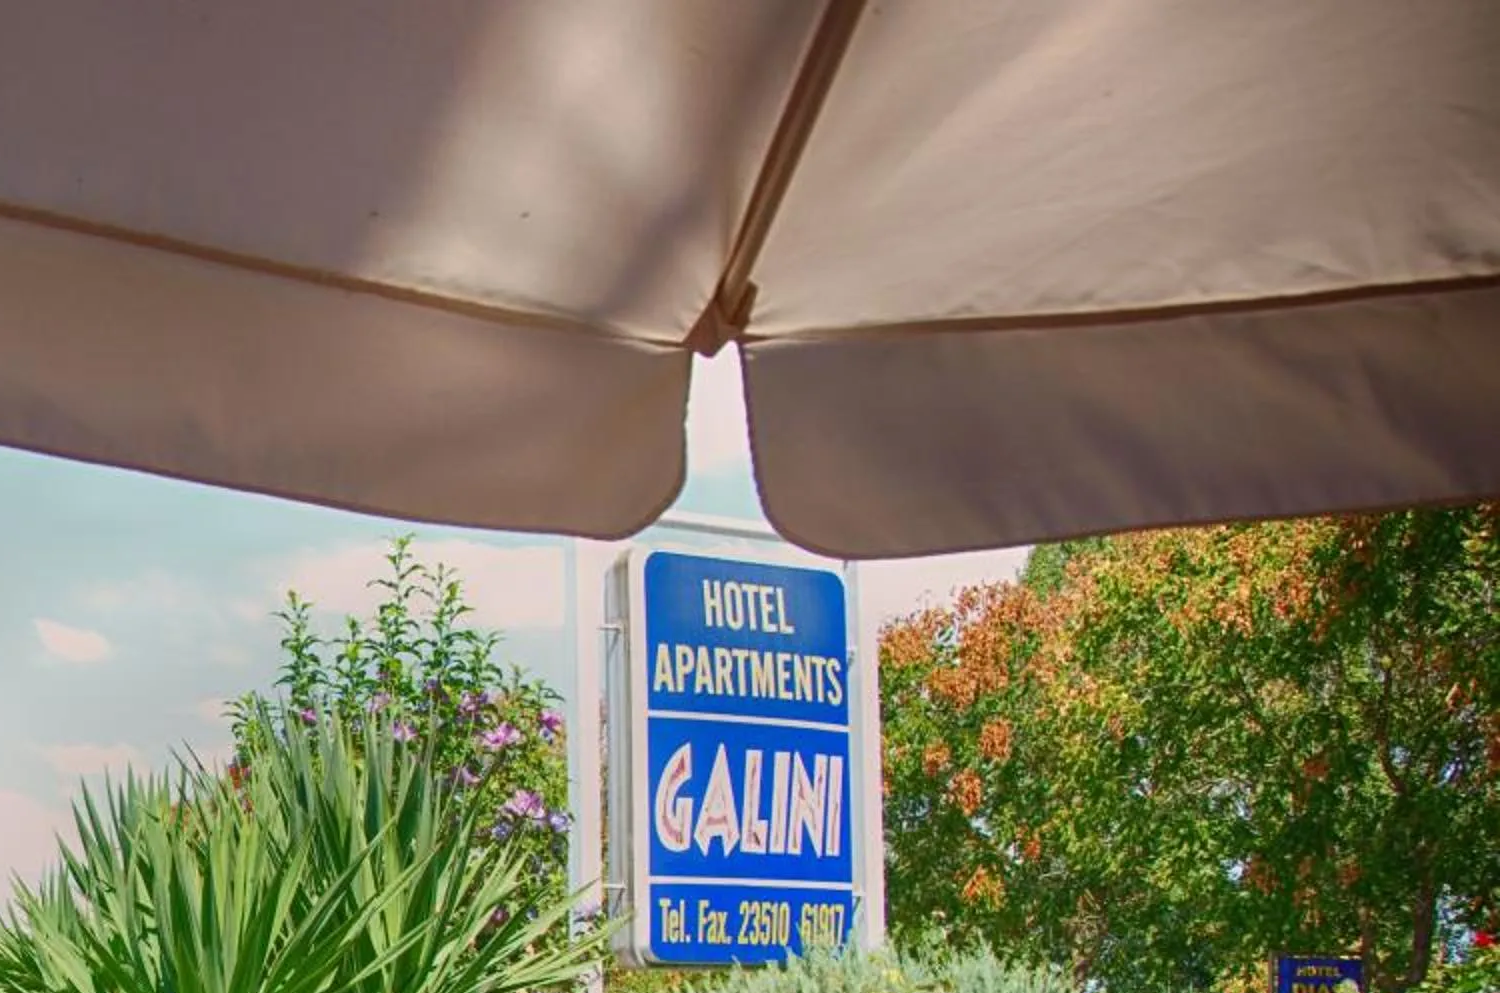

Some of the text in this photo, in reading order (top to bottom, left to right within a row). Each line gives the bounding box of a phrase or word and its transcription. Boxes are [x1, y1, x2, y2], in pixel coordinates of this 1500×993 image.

[703, 579, 795, 635] HOTEL
[653, 643, 842, 706] APARTMENTS
[655, 742, 844, 858] GALINI
[659, 897, 691, 944] Tel.
[697, 899, 732, 945] Fax.
[737, 900, 790, 946] 23510
